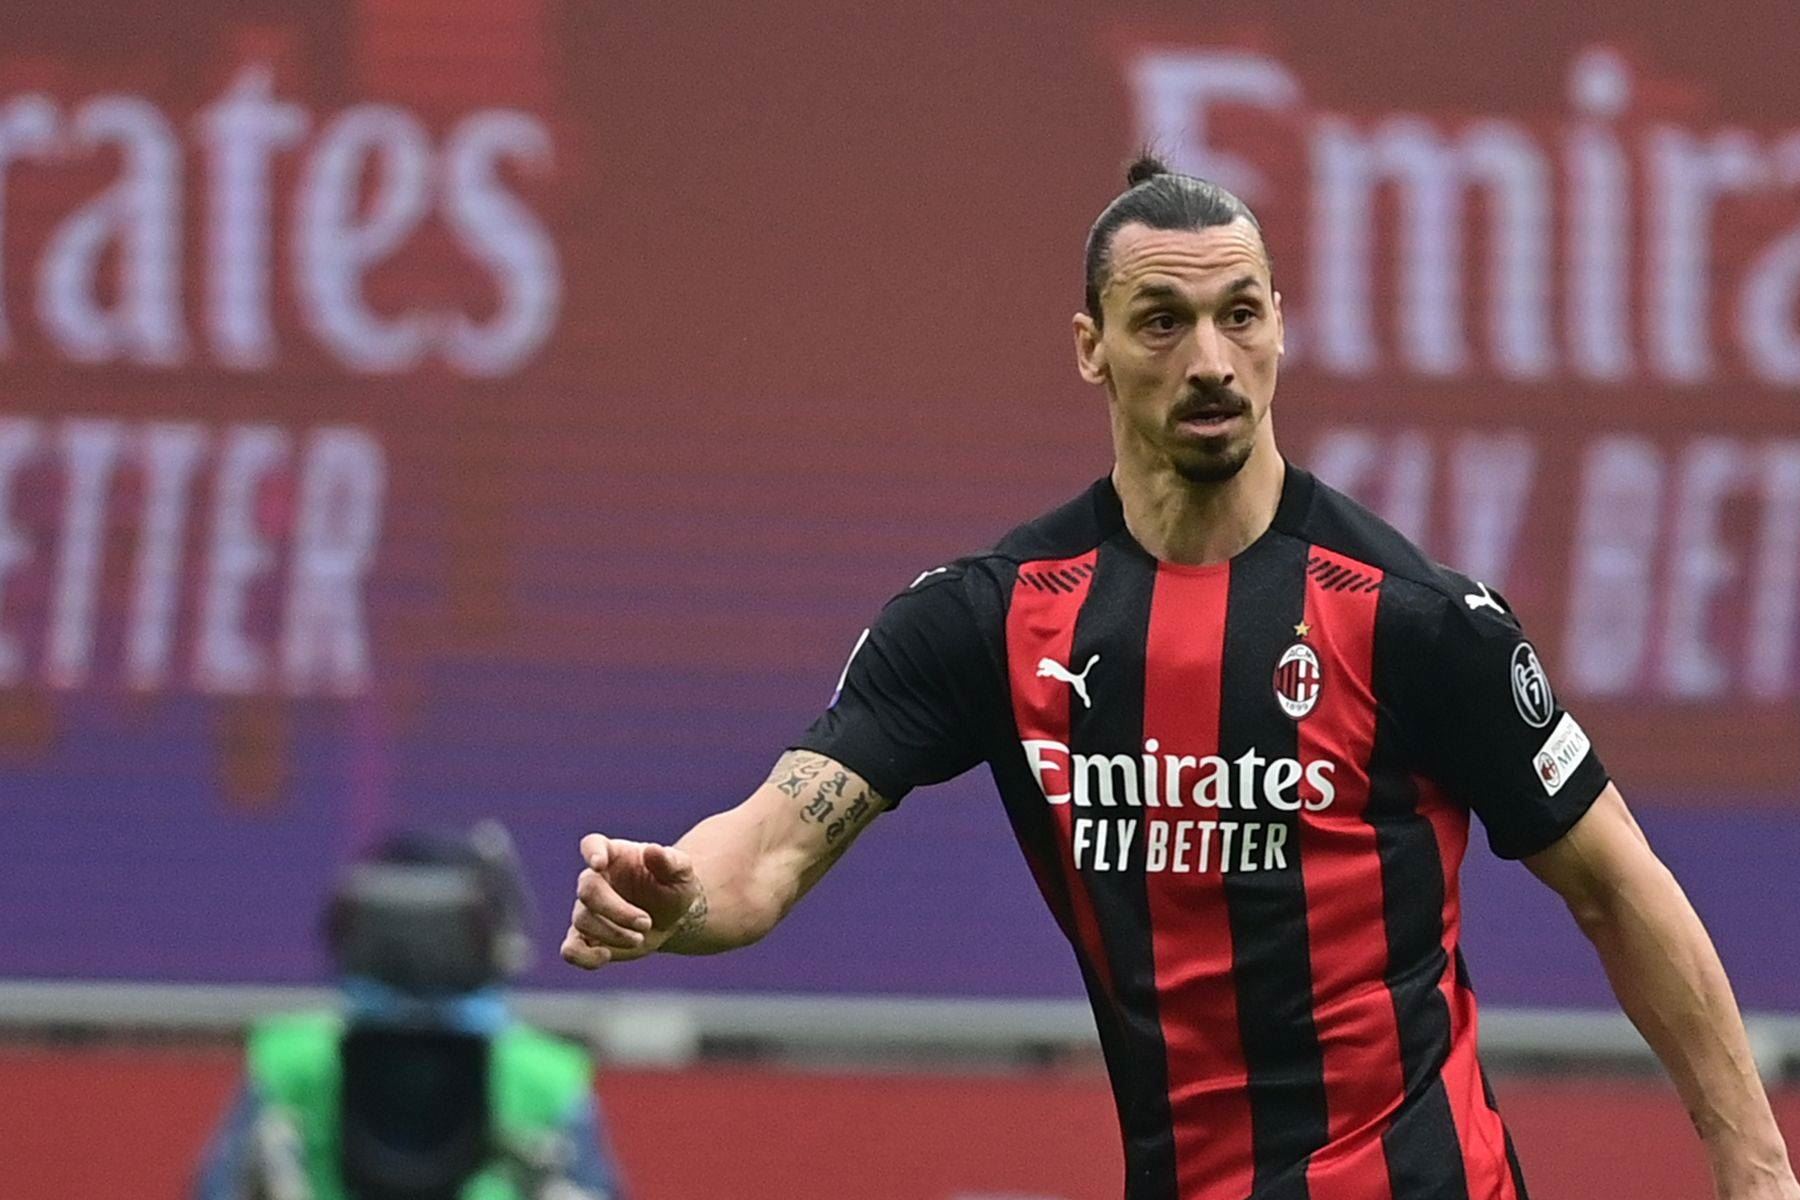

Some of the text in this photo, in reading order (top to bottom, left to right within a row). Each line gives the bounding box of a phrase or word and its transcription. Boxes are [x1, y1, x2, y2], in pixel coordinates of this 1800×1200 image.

[1021, 738, 1336, 811] Emirates
[1073, 818, 1288, 873] FLY BETTER
